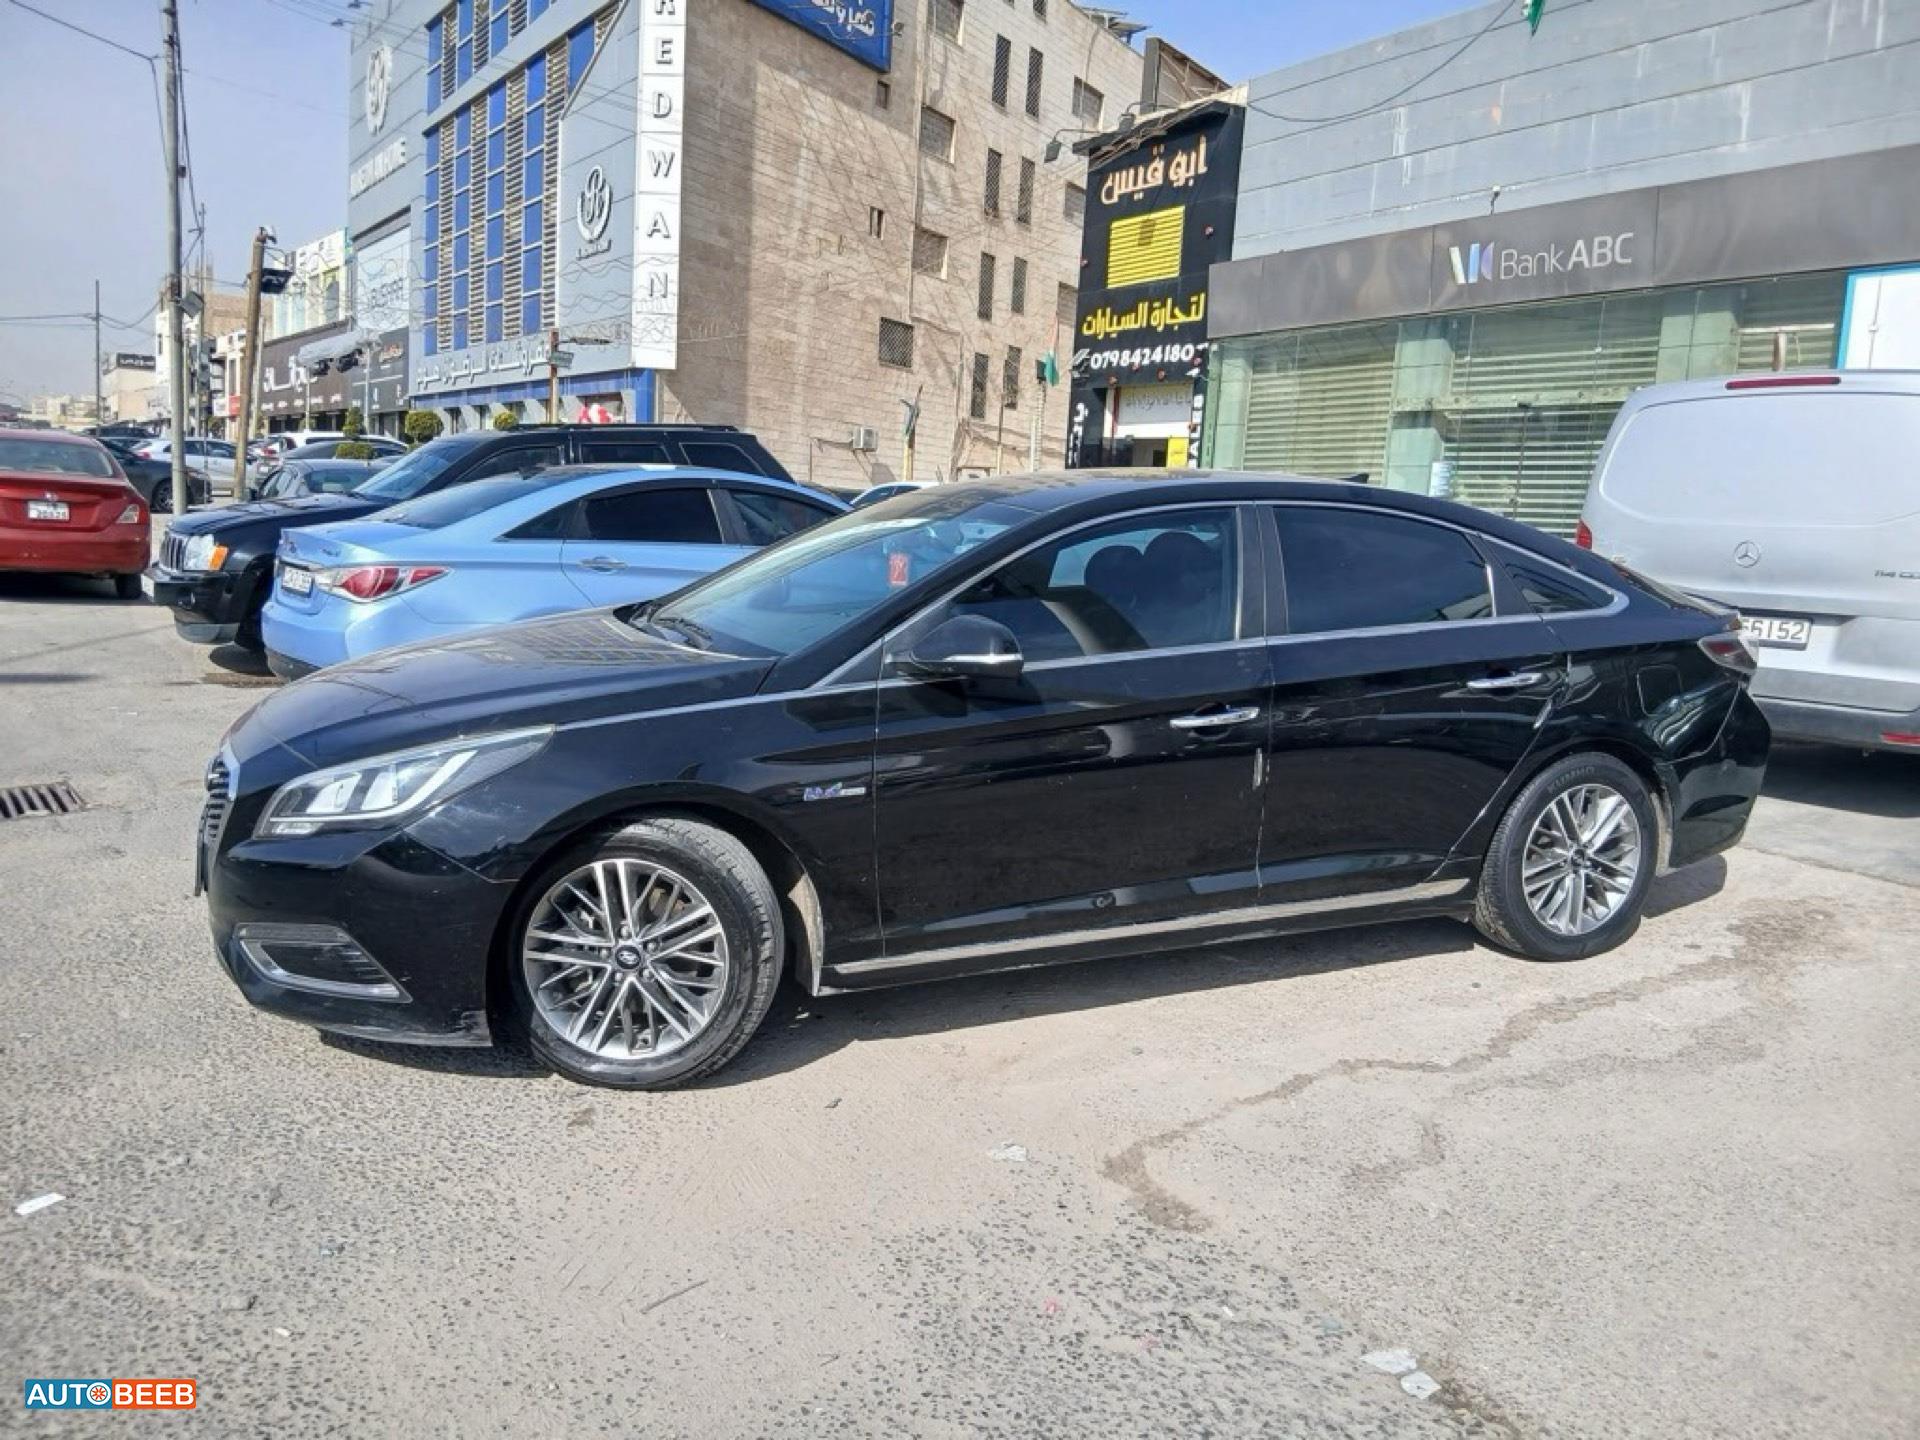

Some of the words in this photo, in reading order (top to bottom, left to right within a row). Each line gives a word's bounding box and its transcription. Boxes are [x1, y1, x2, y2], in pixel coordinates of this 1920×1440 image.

[1101, 142, 1166, 205] قيس
[1168, 133, 1208, 188] ابو
[1500, 243, 1566, 280] Bank
[1567, 232, 1634, 271] ABC
[1082, 301, 1150, 340] السيارات
[1150, 292, 1206, 333] لتجارة
